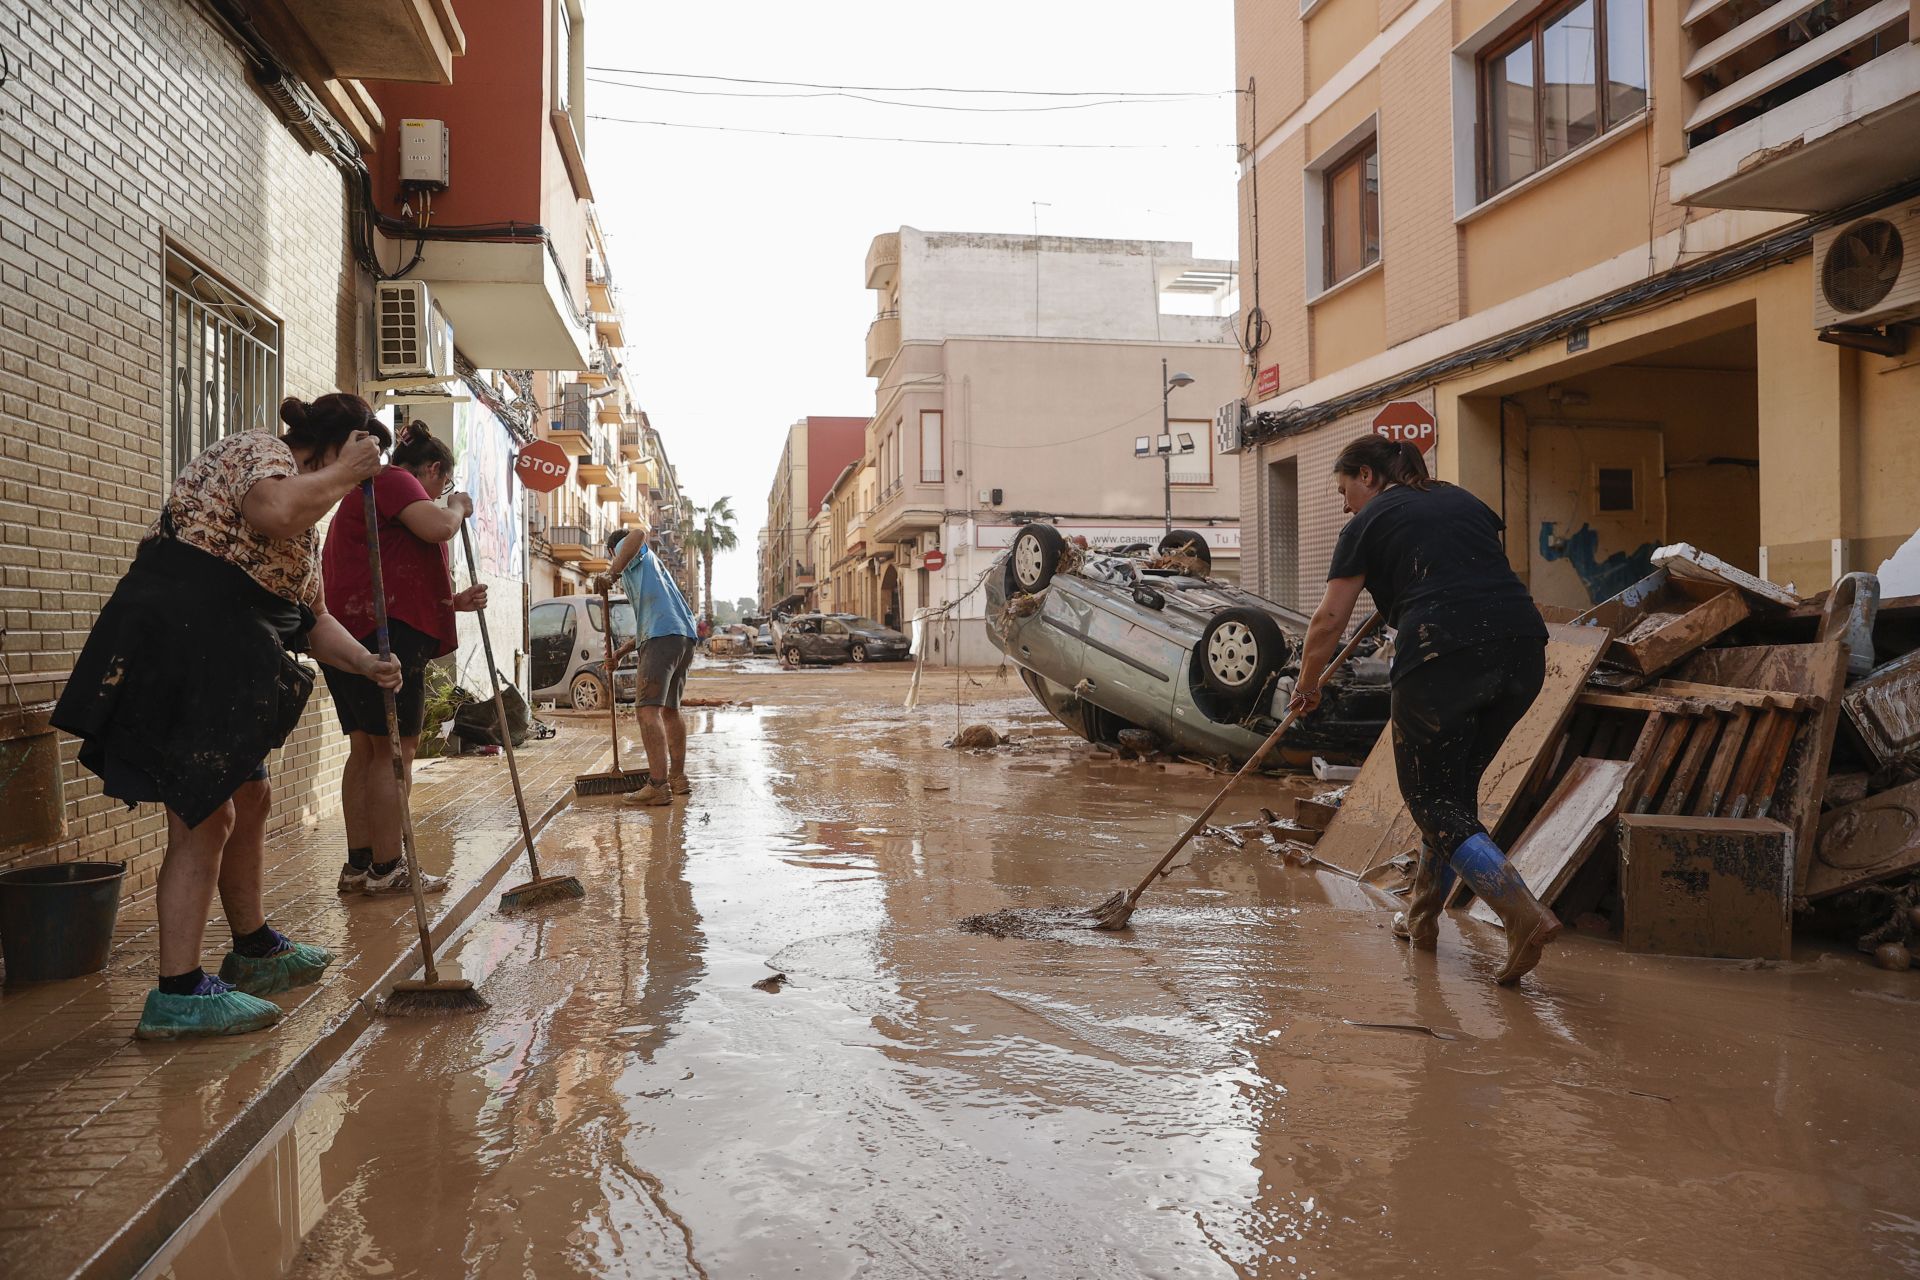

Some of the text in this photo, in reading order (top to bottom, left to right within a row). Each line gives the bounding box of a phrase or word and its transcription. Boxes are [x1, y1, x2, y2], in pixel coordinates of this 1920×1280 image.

[1376, 423, 1433, 440] STOP
[520, 455, 566, 477] STOP
[1215, 533, 1229, 544] Tu
